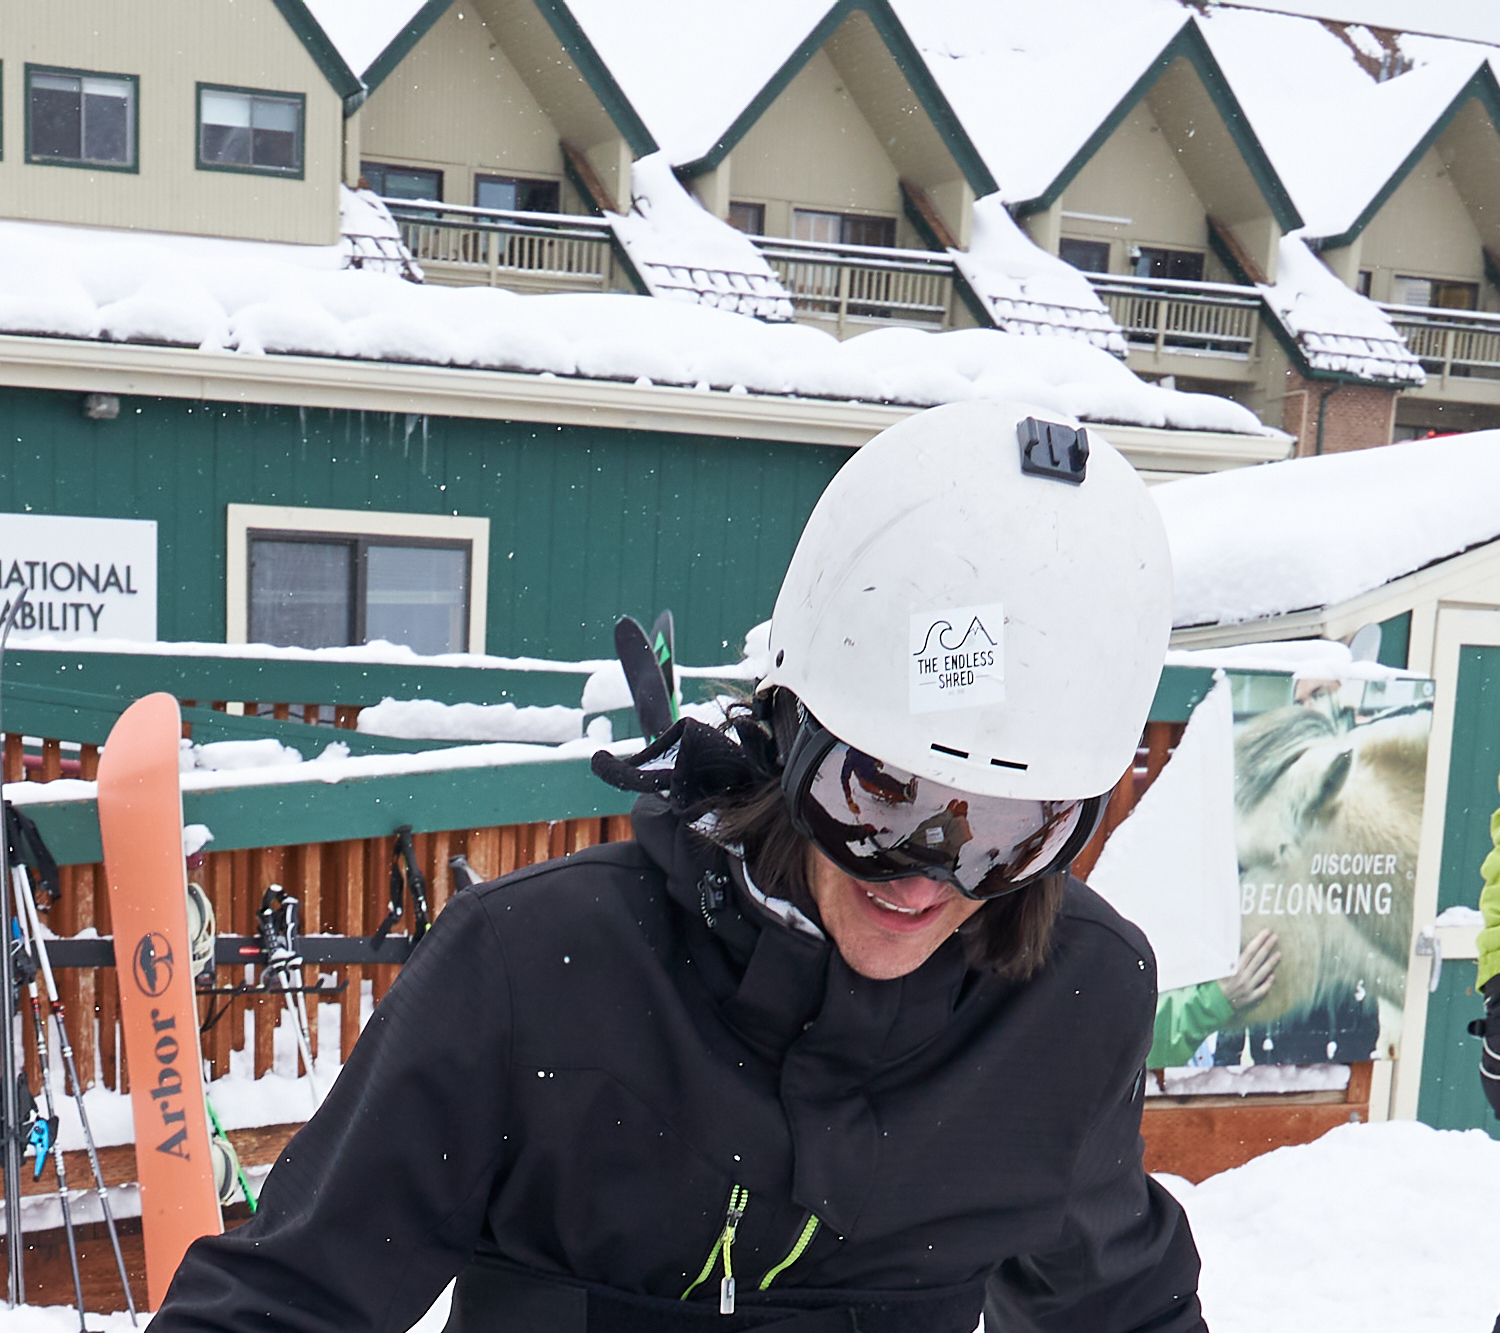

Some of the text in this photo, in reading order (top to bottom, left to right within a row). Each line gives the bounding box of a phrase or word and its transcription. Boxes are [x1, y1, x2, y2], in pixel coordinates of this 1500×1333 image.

[917, 650, 994, 674] THE ENDLESS
[938, 670, 974, 689] SHRED
[1310, 853, 1397, 875] DISCOVER
[1241, 882, 1393, 916] BELONGING
[150, 1008, 190, 1162] Arbor
